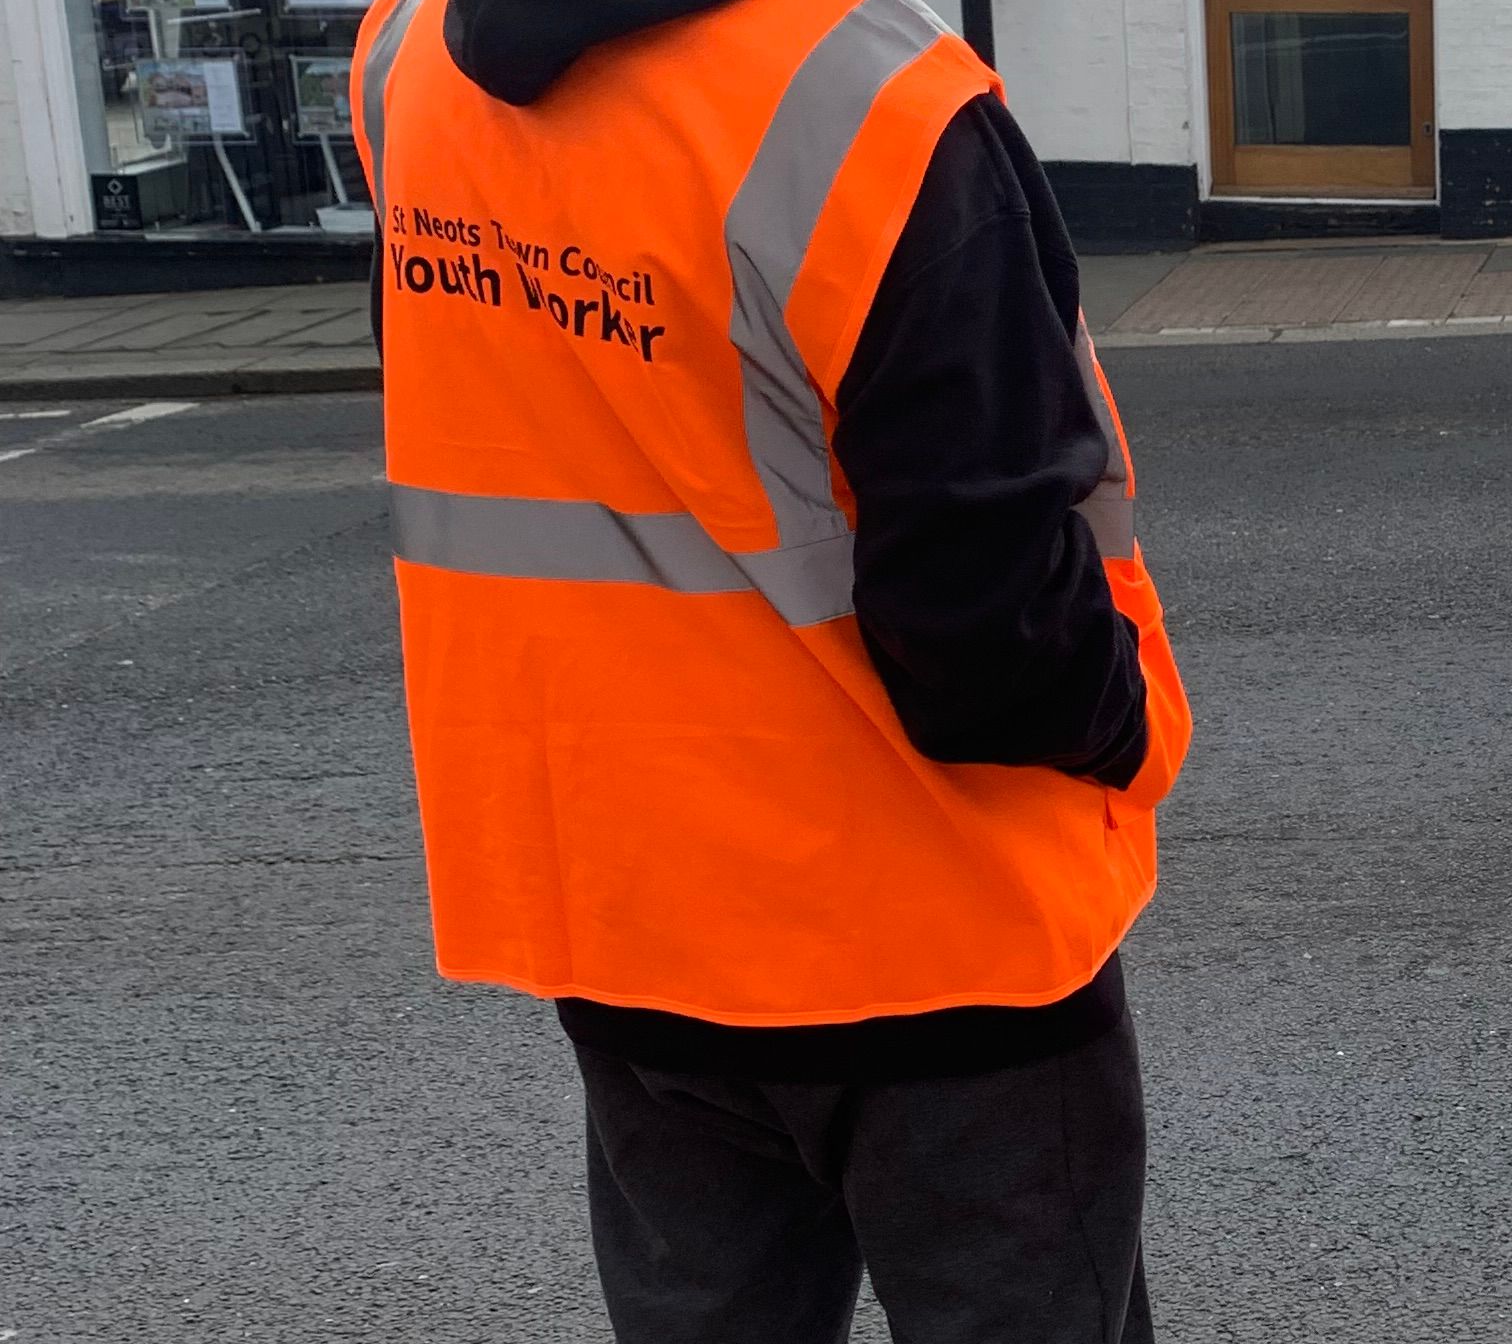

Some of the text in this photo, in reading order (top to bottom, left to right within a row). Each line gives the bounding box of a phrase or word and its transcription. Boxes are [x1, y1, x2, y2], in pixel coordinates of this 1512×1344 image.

[393, 205, 407, 235] St
[413, 207, 481, 247] Neots
[390, 243, 501, 307] Youth
